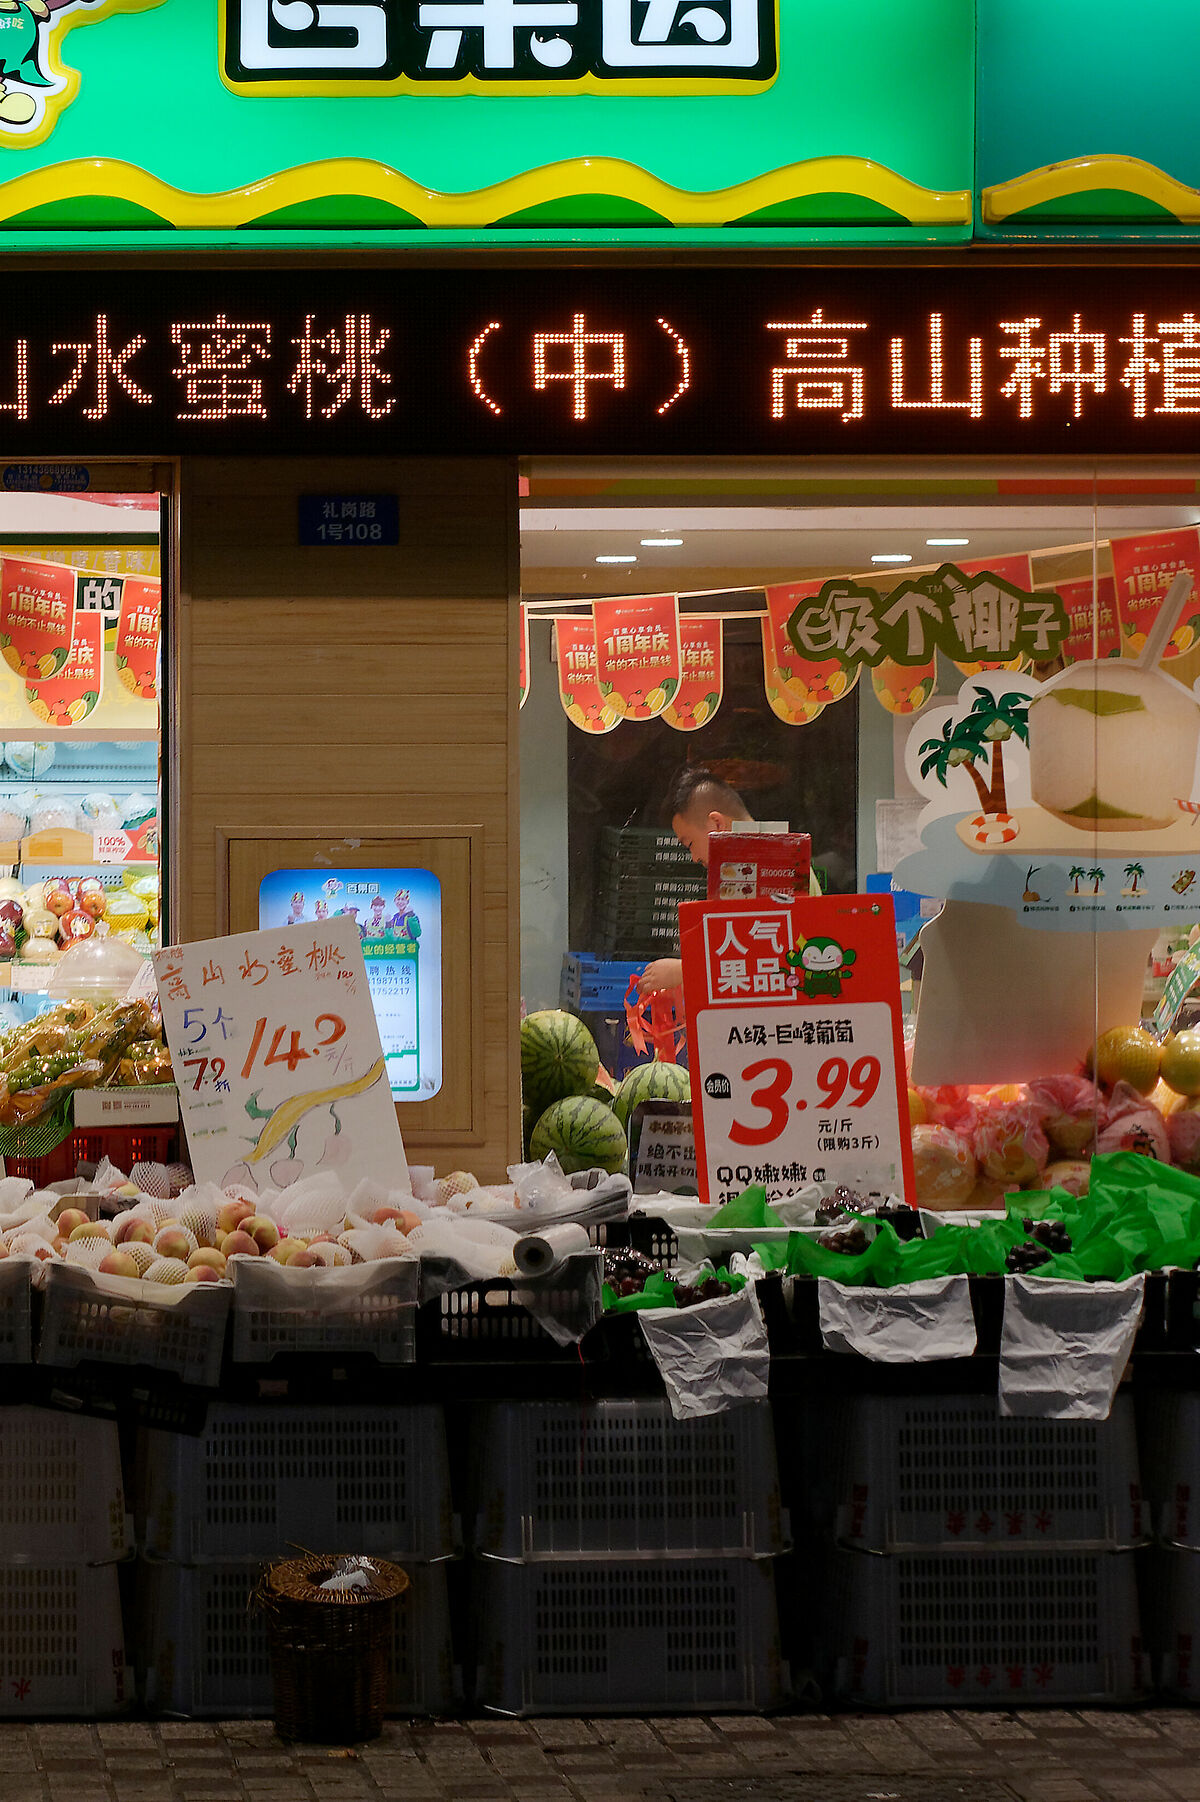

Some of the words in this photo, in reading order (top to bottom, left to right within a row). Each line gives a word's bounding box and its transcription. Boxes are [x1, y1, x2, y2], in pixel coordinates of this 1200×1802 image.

[322, 501, 377, 518] 礼岗路
[316, 523, 383, 541] 1号108
[7, 590, 68, 621] 1周年庆
[603, 631, 670, 657] 1周年庆
[605, 655, 672, 672] 省的不止是钱
[98, 836, 126, 846] 100%
[715, 920, 784, 957] 人气
[717, 959, 786, 994] 果品
[183, 1007, 234, 1044] 5个
[727, 1020, 855, 1046] A级-巨峰葡萄
[705, 1078, 730, 1095] 会员价
[727, 1055, 881, 1147] 3.99
[817, 1118, 853, 1134] 元/斤
[816, 1135, 881, 1152] (限购3斤)
